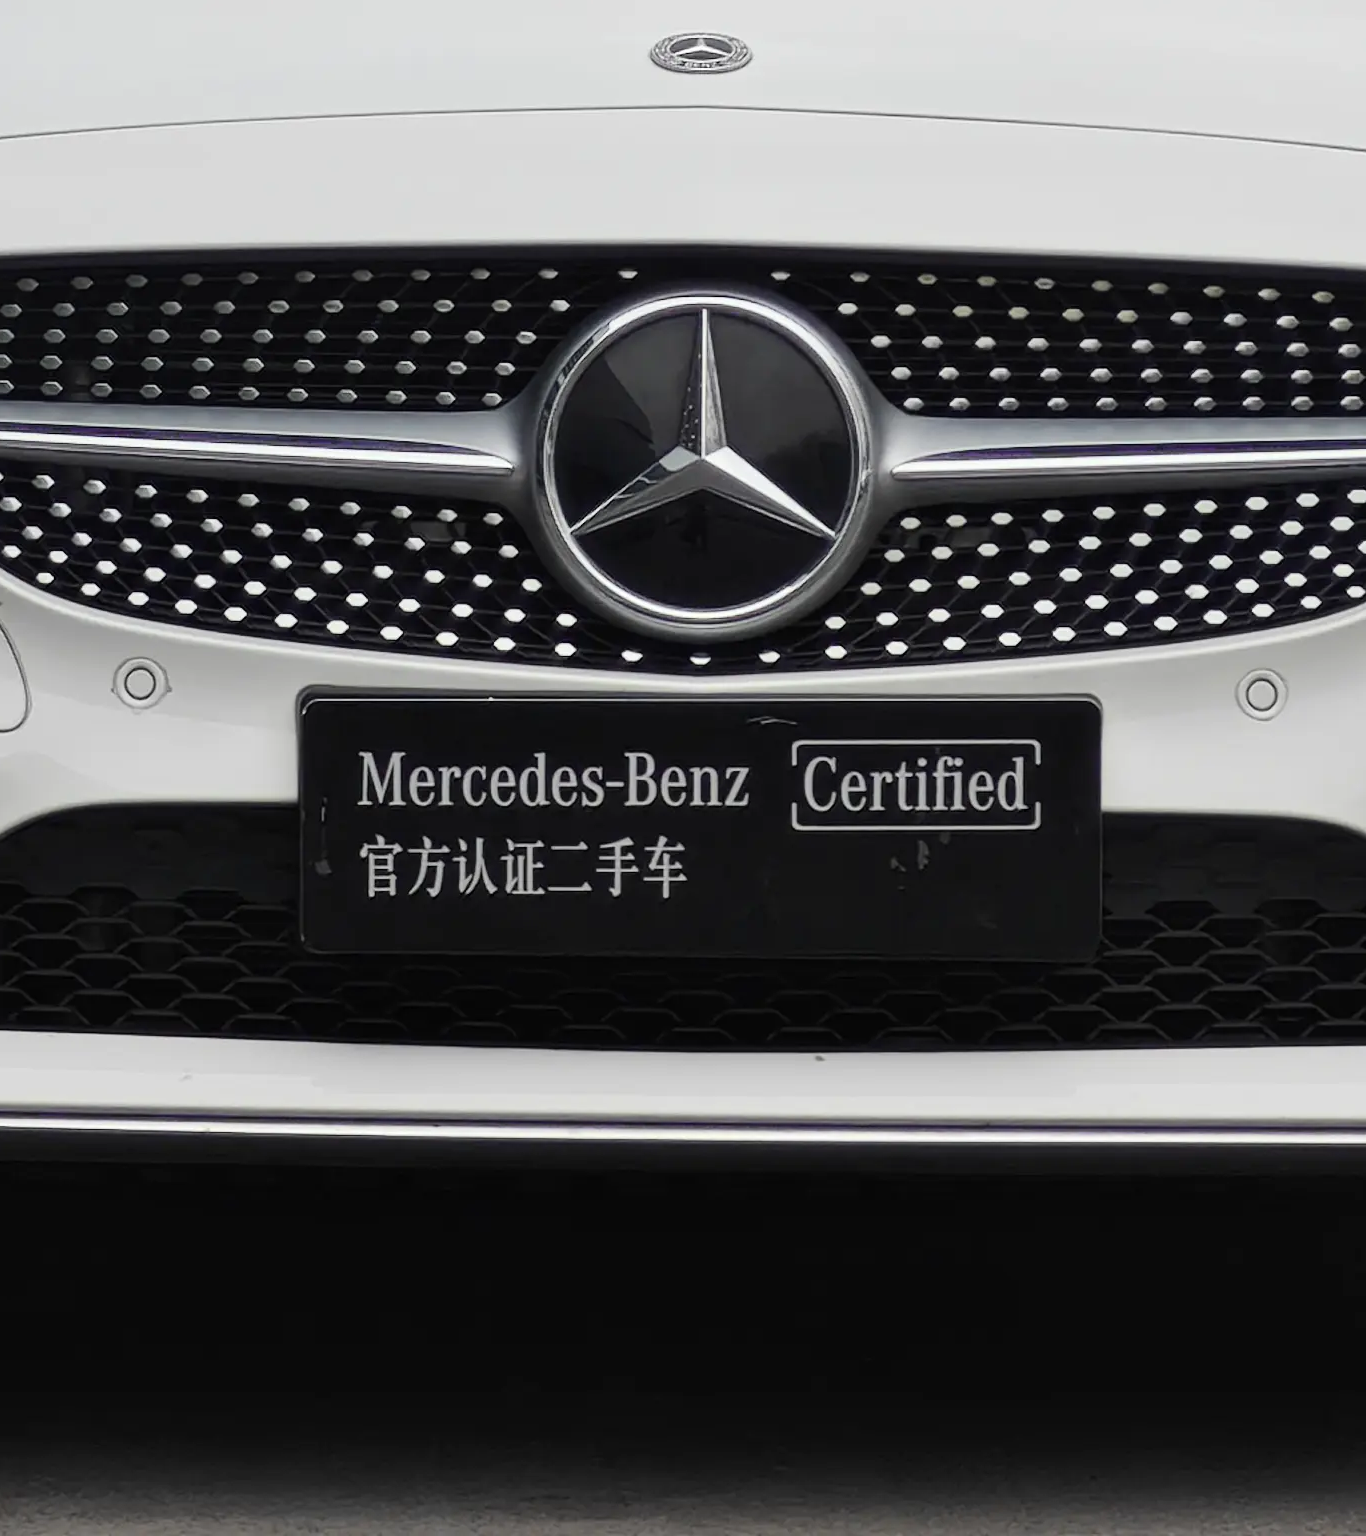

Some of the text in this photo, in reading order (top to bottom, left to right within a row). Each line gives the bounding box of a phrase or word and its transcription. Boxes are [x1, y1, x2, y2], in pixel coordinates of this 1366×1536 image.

[357, 750, 1028, 813] Mercedes-Benz Certified
[358, 834, 689, 900] 官方认证二手车
